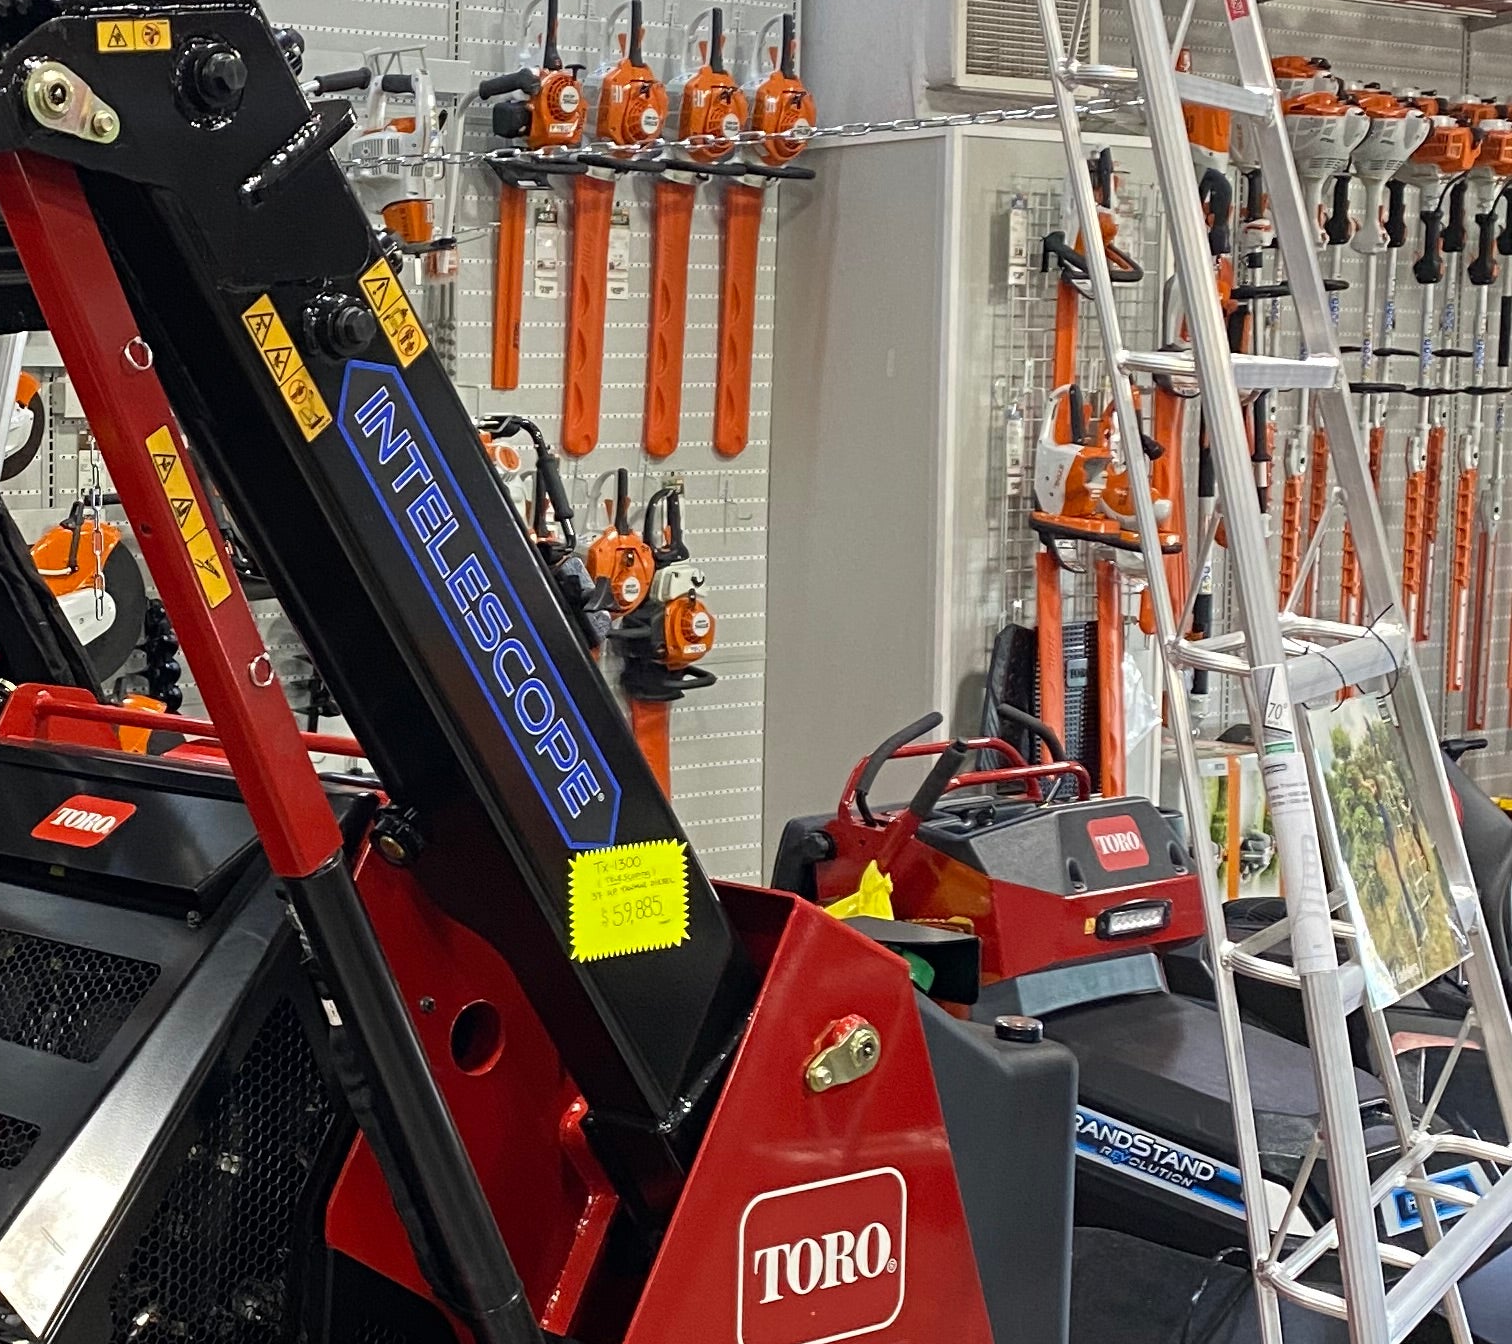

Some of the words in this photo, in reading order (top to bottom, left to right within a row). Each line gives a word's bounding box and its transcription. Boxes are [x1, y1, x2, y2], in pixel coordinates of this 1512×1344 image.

[354, 385, 600, 820] INTELESCOPE
[49, 807, 117, 835] TORO
[1094, 831, 1140, 855] TORO
[1076, 1113, 1215, 1182] RANDSTAND
[753, 1222, 891, 1304] TORO
